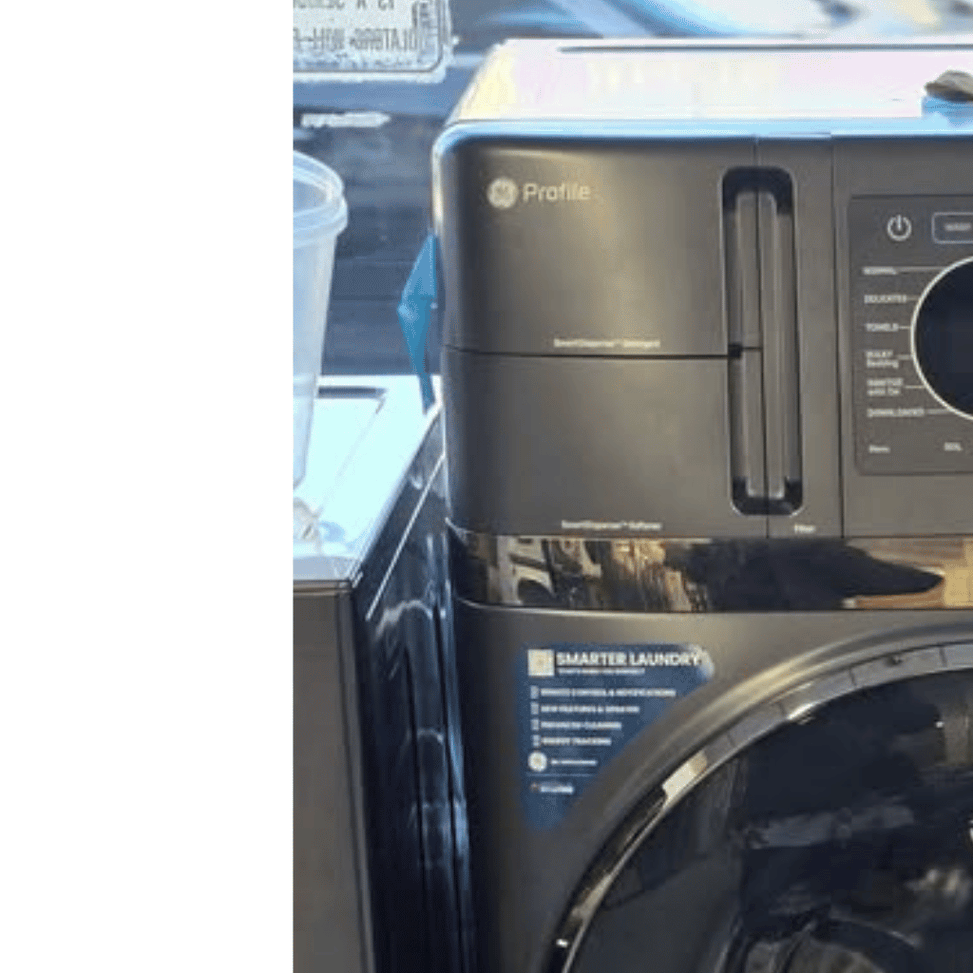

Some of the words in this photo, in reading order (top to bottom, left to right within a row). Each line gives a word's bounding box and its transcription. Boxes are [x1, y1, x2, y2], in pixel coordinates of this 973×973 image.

[523, 183, 591, 201] Profile
[864, 294, 907, 304] DELICATES
[556, 652, 628, 667] SMARTER
[629, 652, 701, 667] LAUNDRY
